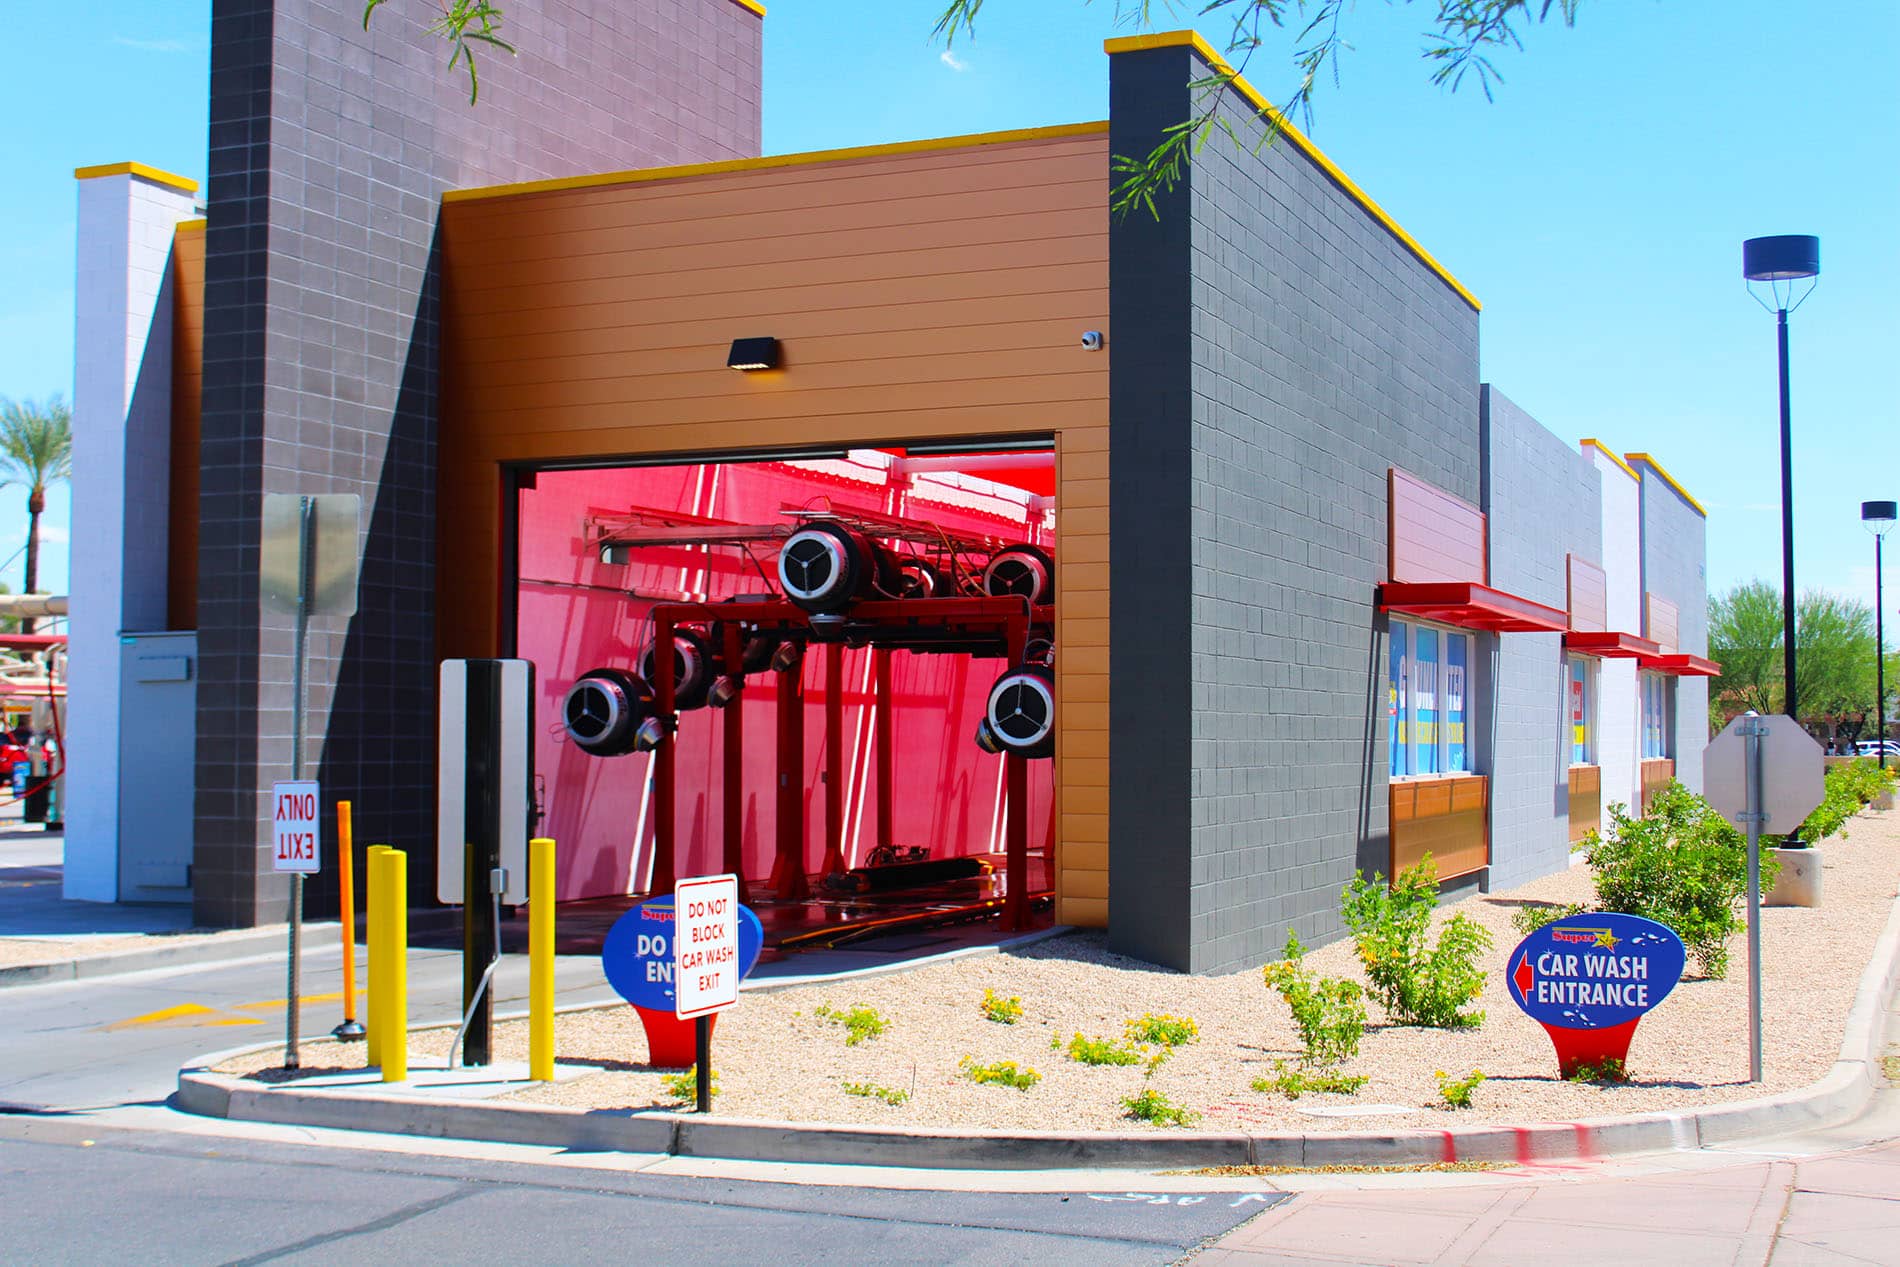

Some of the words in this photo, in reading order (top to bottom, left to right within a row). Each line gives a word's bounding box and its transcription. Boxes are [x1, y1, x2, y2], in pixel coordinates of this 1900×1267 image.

[276, 794, 315, 820] ONLY
[278, 833, 314, 859] EXIT
[641, 909, 676, 923] Supe
[688, 902, 705, 918] DO
[707, 898, 727, 916] NOT
[692, 923, 725, 943] BLOCK
[1552, 931, 1596, 944] Super
[637, 934, 667, 957] DO
[682, 952, 703, 969] CAR
[705, 946, 734, 965] WASH
[1537, 953, 1578, 977] CAR
[1584, 954, 1648, 980] WASH
[698, 973, 720, 991] EXIT
[1537, 981, 1648, 1007] ENTRANCE
